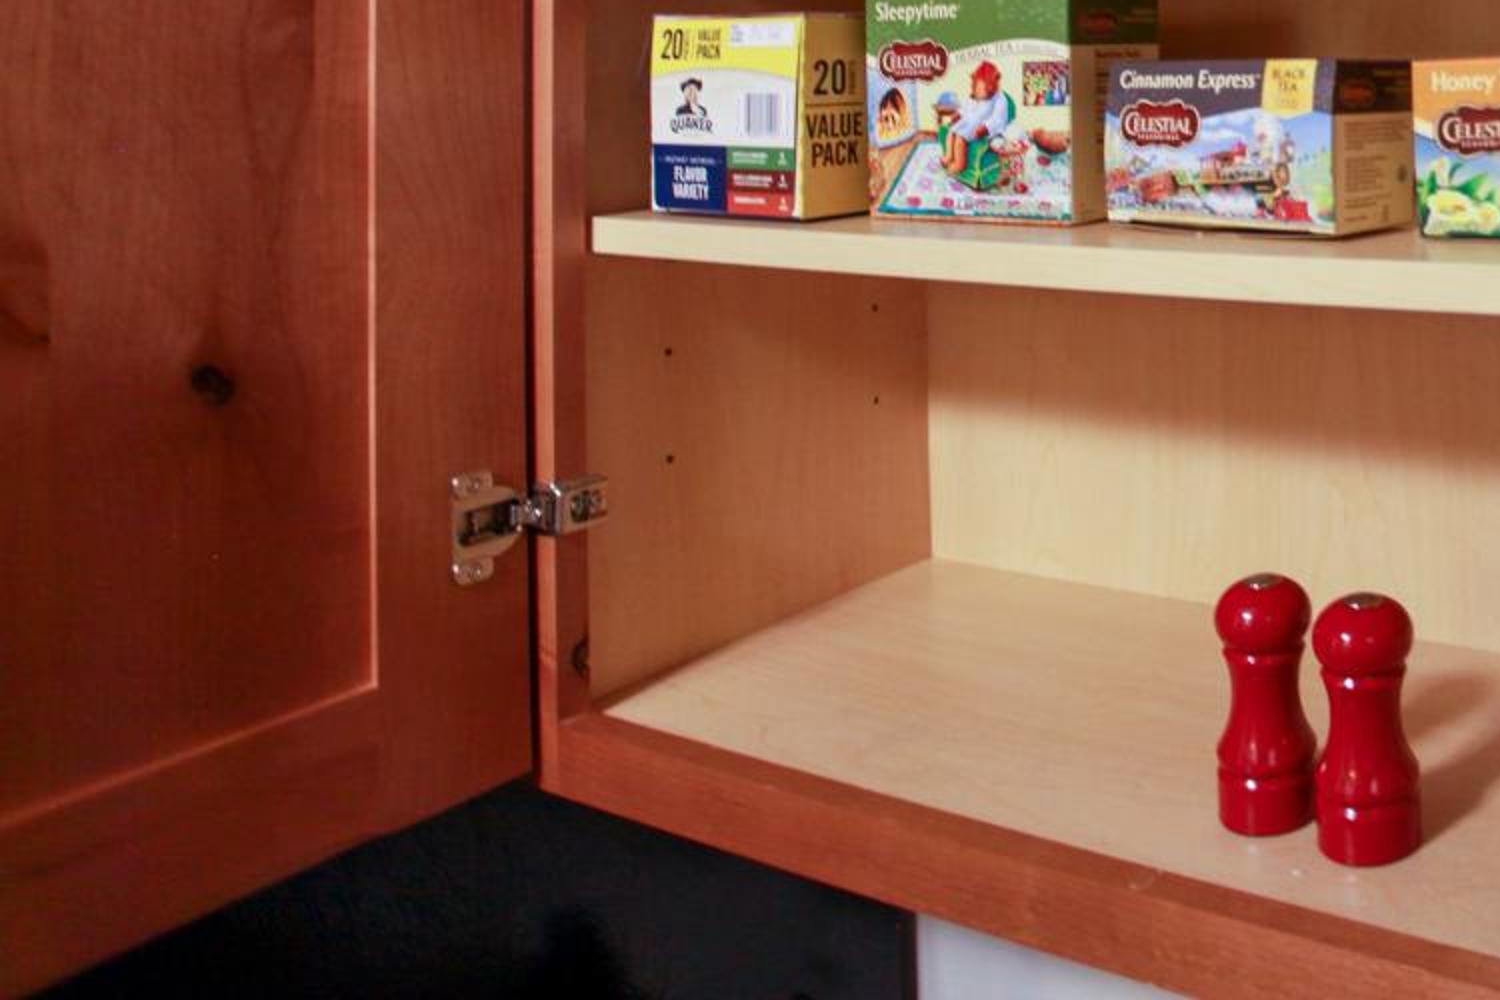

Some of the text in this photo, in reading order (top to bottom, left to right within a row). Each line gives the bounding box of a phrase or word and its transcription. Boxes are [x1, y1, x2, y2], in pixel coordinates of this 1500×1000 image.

[875, 0, 957, 26] Sleepytime
[661, 28, 684, 59] 20
[882, 51, 943, 72] CELESTIAL
[813, 59, 847, 95] 20
[1120, 69, 1256, 95] Cinnamon Express
[1431, 71, 1497, 95] Honey
[806, 112, 864, 139] VALUE
[1125, 111, 1192, 136] CELESTIAL
[811, 140, 859, 168] PACK
